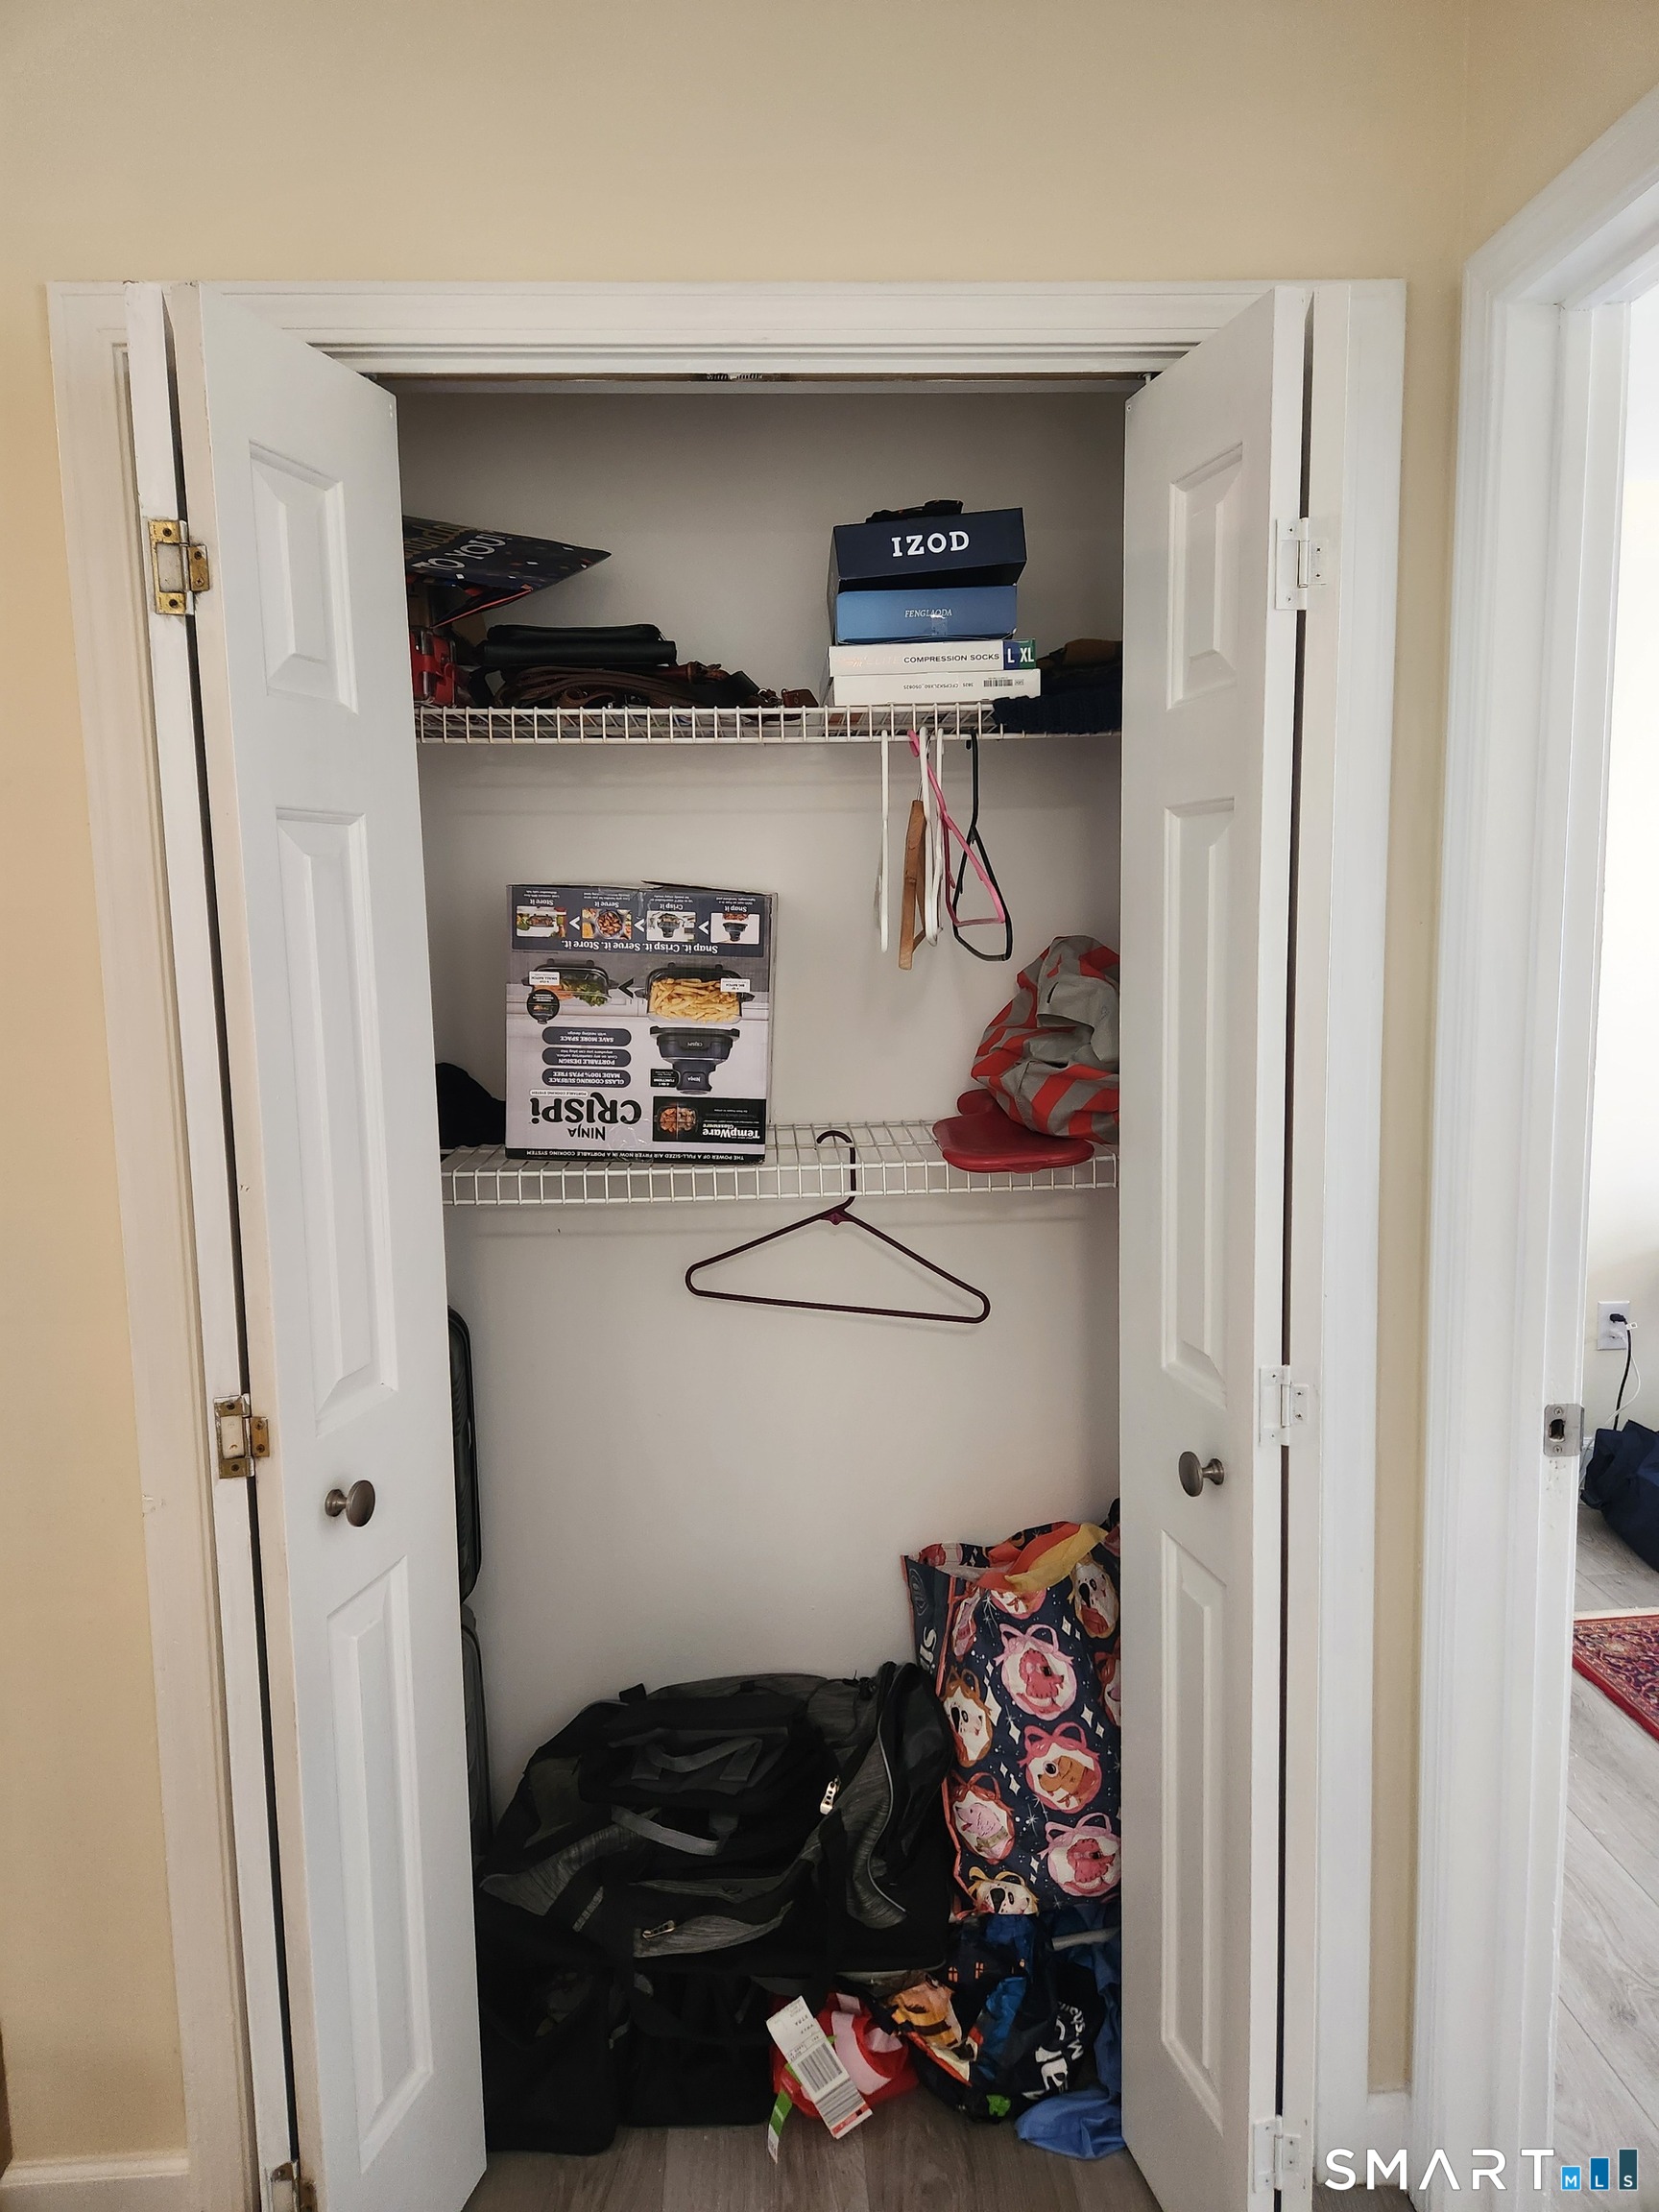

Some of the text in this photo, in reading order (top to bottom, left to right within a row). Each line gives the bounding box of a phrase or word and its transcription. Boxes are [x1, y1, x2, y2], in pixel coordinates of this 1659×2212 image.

[411, 558, 466, 570] TO
[445, 533, 513, 560] YOU!
[891, 530, 970, 558] IZOD
[903, 655, 968, 663] COMPRESSION
[1007, 647, 1034, 663] L XL
[665, 902, 684, 911] Crisp
[561, 940, 718, 954] Snap it. Crisp it. Serve it. Store it.
[567, 1123, 606, 1142] NINJA
[702, 1127, 760, 1139] TempWare
